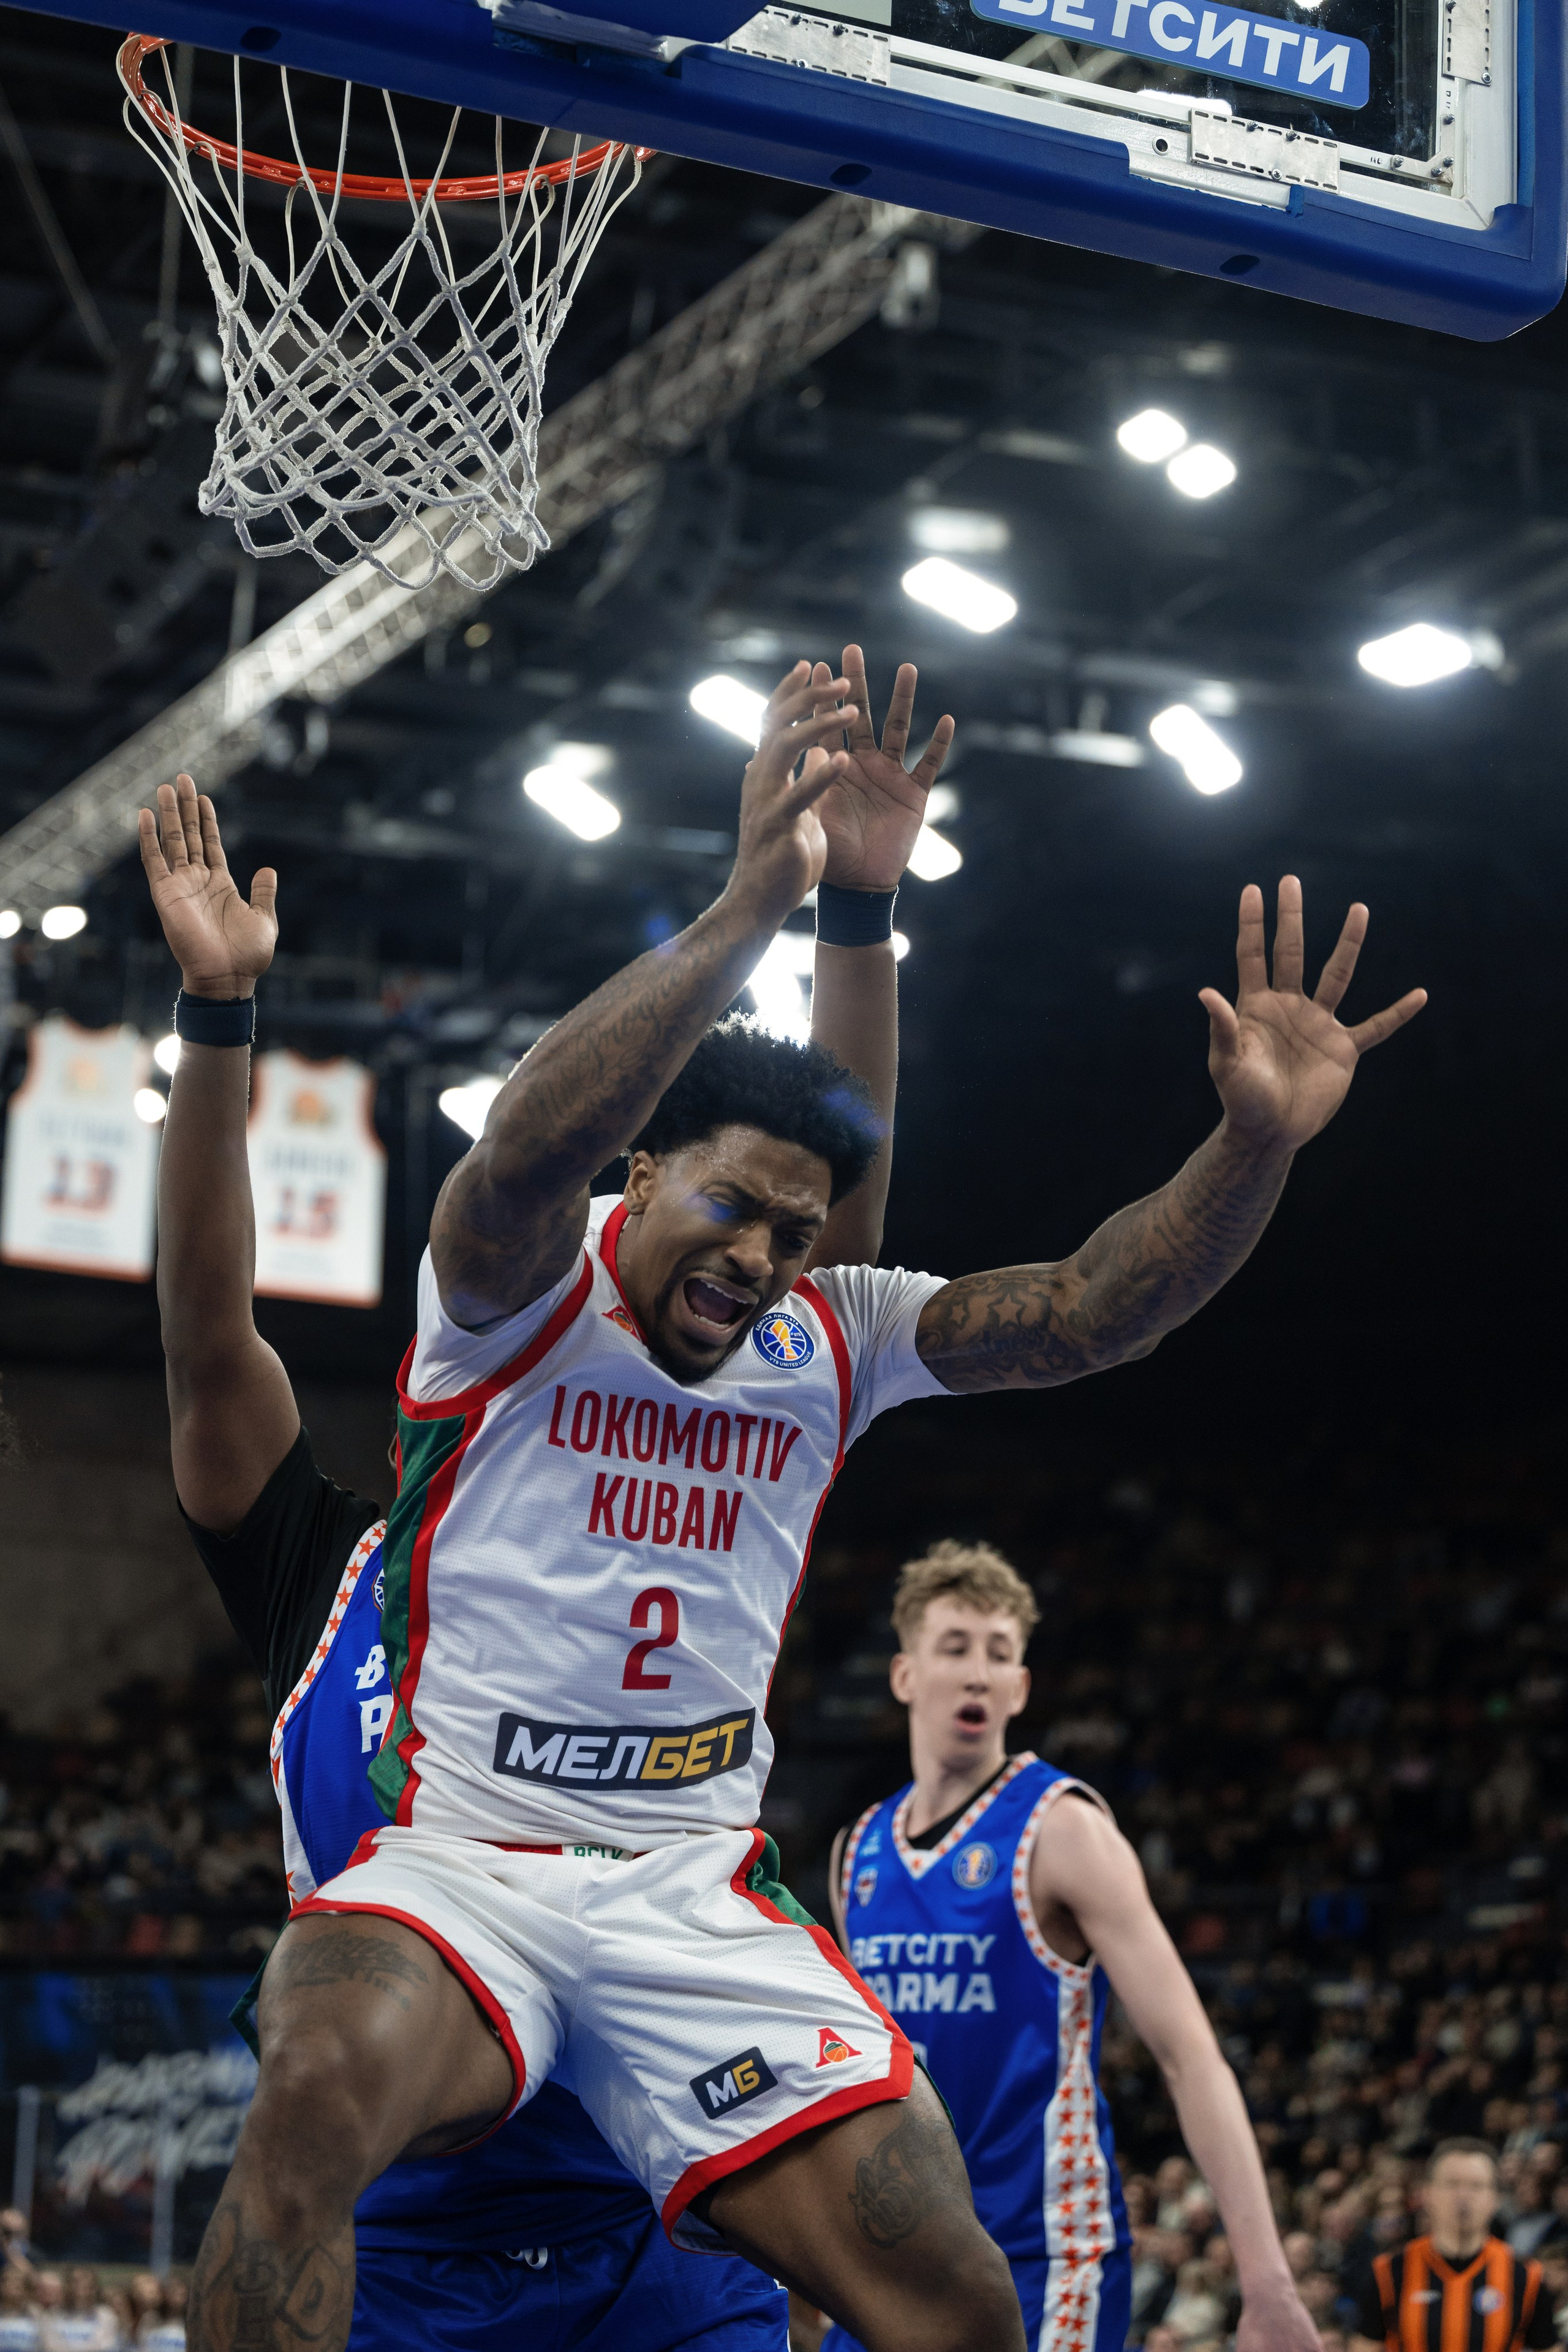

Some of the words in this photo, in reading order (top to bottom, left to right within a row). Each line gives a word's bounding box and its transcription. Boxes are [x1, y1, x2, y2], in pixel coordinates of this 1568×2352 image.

[755, 1315, 772, 1331] ЕДИНАЯ
[799, 1351, 812, 1365] LEAGUE
[548, 1385, 802, 1482] LOKOMOTIV
[587, 1472, 743, 1552] KUBAN
[622, 1587, 679, 1691] 2
[505, 1718, 749, 1780] МЕЛБЕТ
